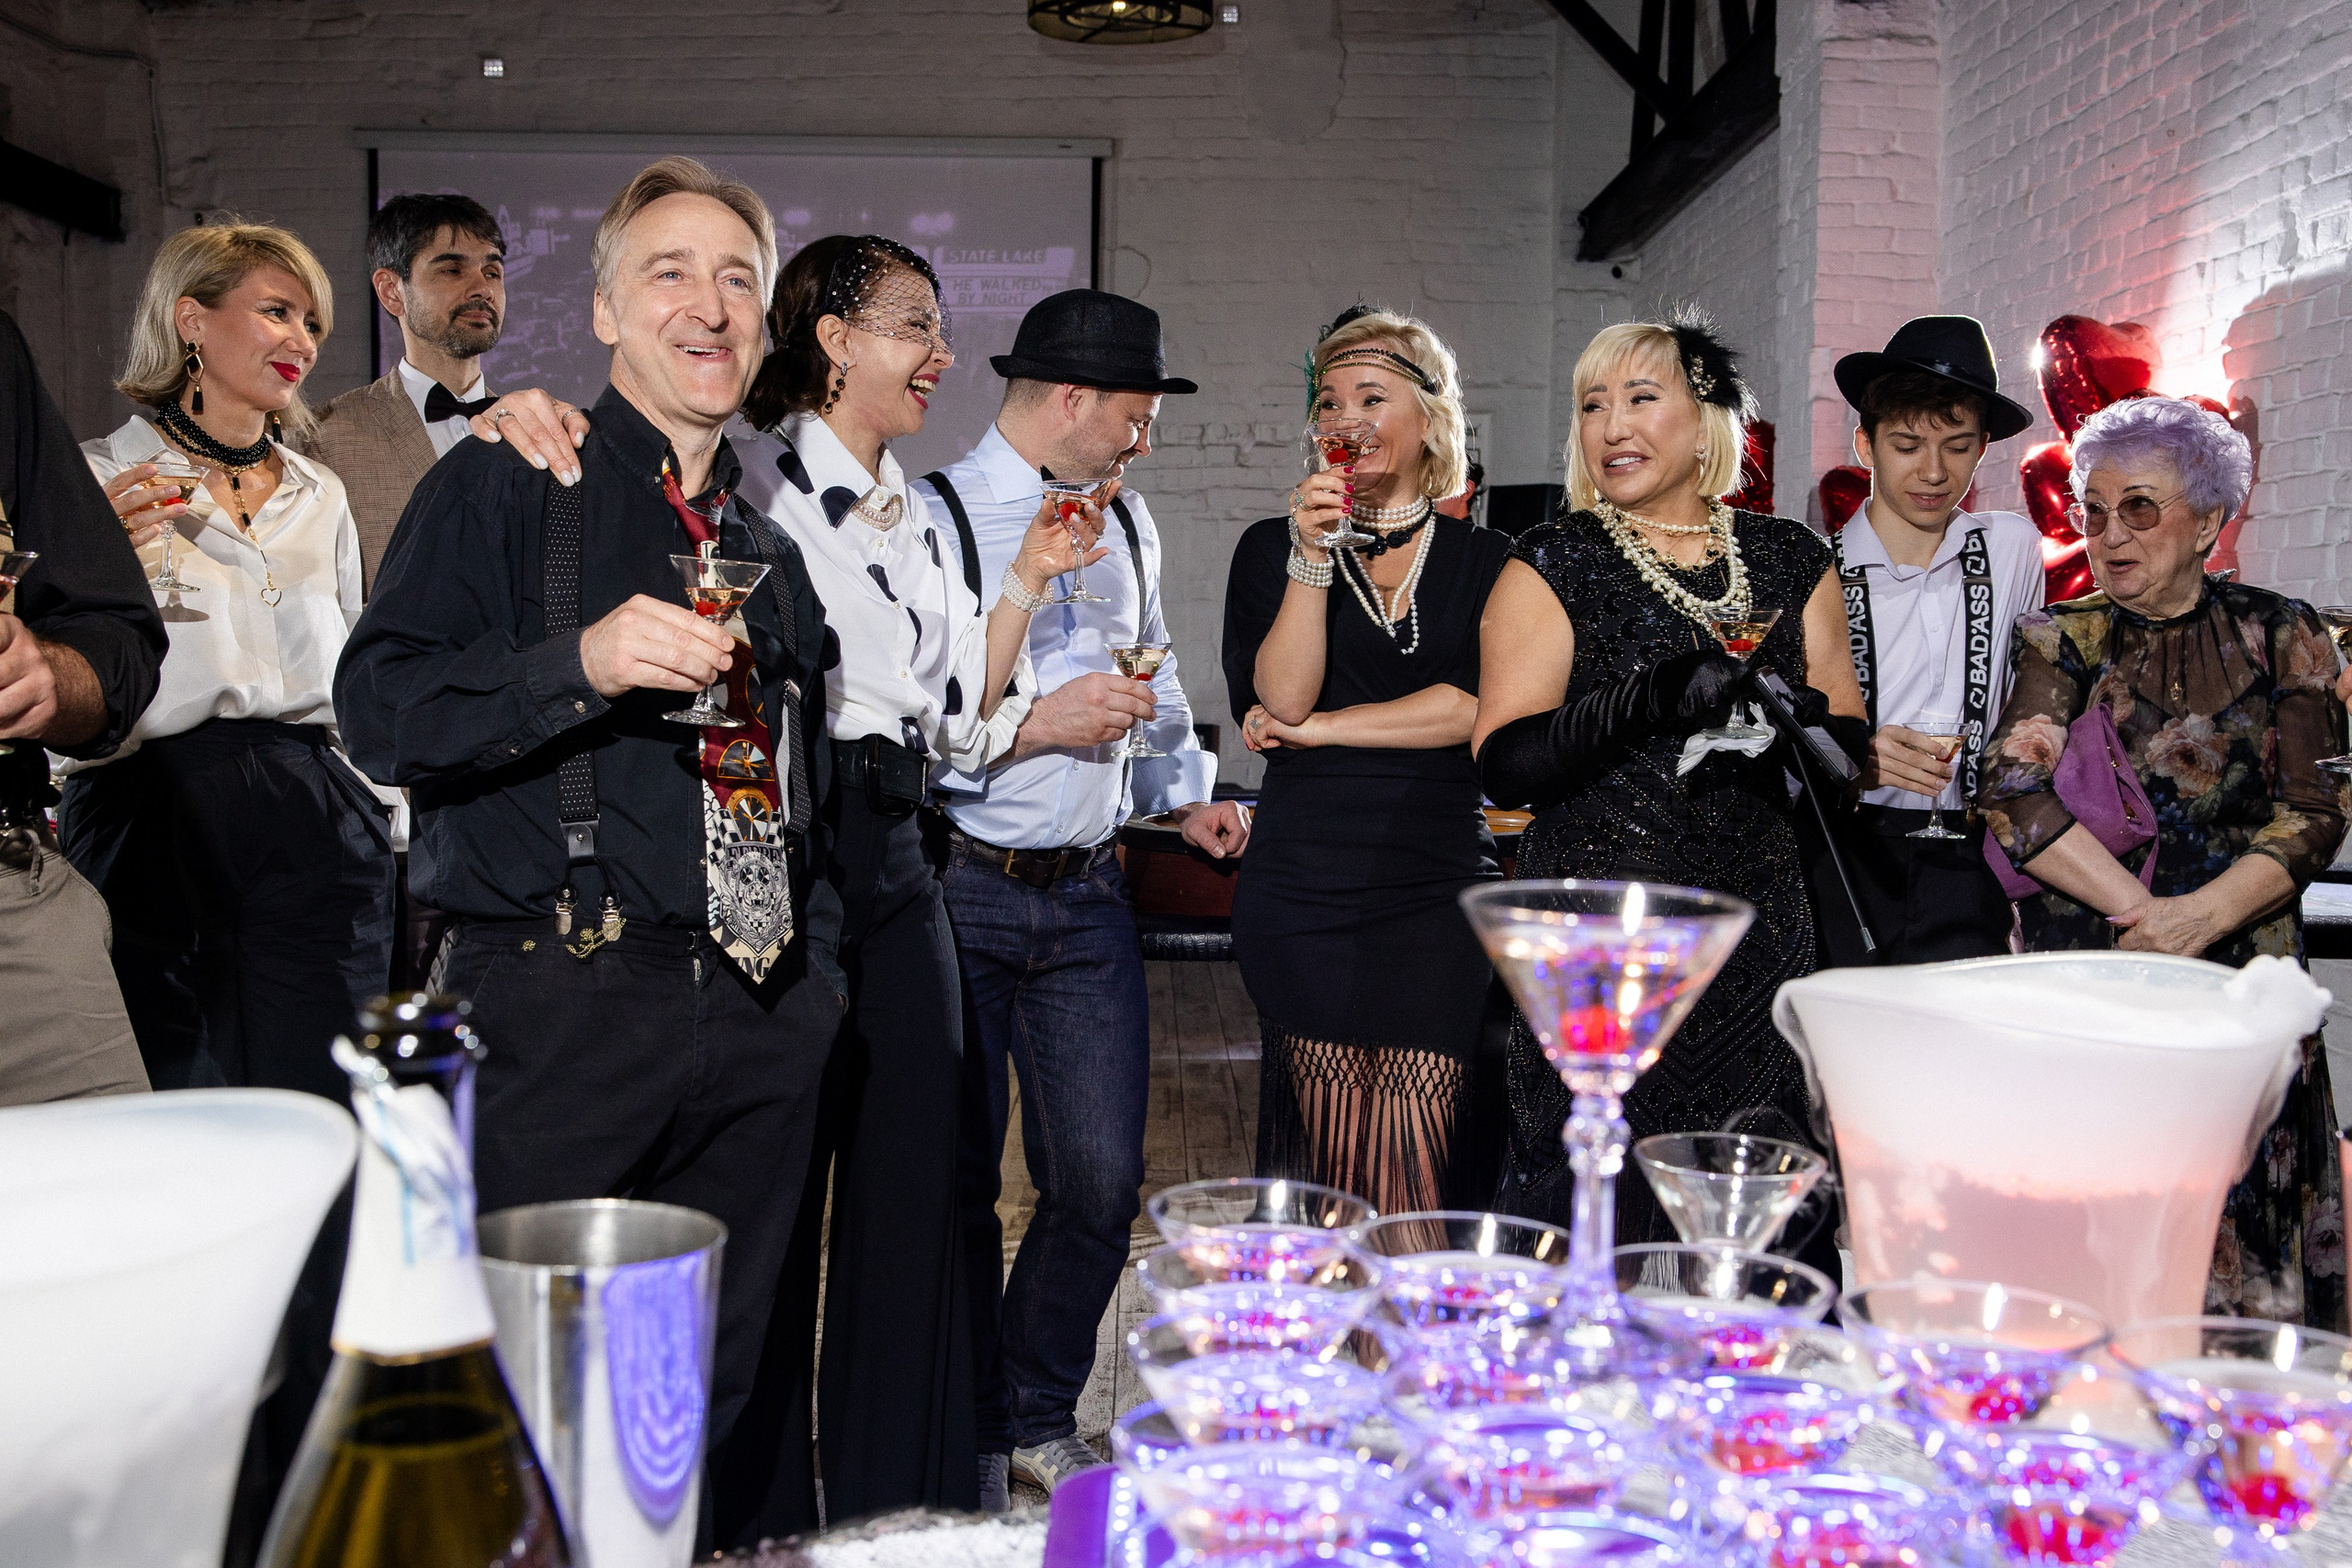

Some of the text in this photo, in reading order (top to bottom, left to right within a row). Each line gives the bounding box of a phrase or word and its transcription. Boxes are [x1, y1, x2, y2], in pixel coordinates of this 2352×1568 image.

[948, 250, 1044, 263] STATE LAKE
[953, 277, 973, 290] HE
[980, 277, 1042, 290] WALKED
[958, 292, 1027, 305] BY NIGHT
